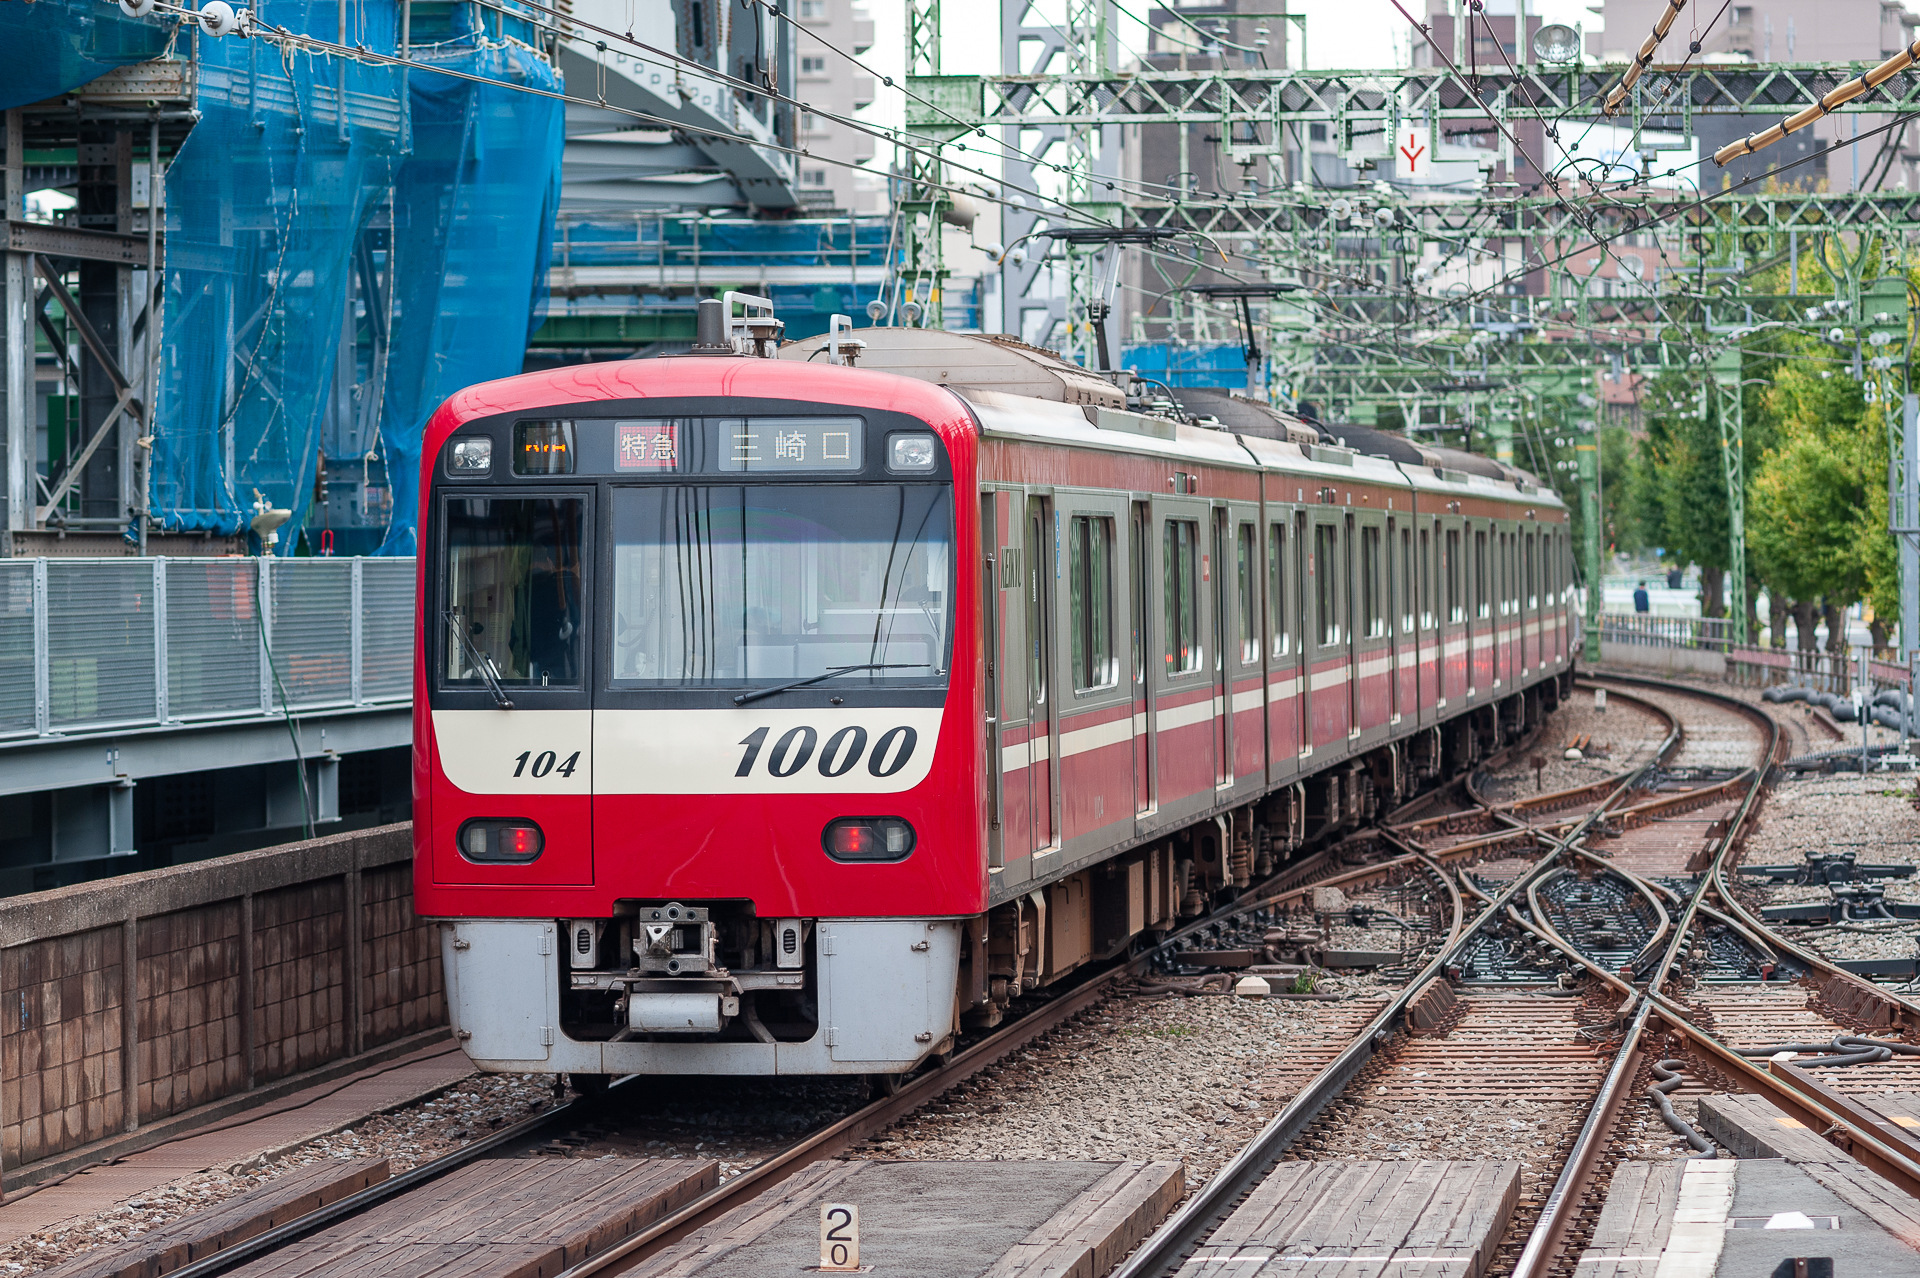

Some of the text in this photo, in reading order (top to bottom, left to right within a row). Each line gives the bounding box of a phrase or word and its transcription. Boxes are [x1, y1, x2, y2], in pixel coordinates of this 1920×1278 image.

[621, 433, 675, 460] 特急
[731, 430, 850, 461] 三崎口
[512, 750, 582, 778] 104
[734, 725, 918, 778] 1000
[826, 1208, 852, 1241] 2
